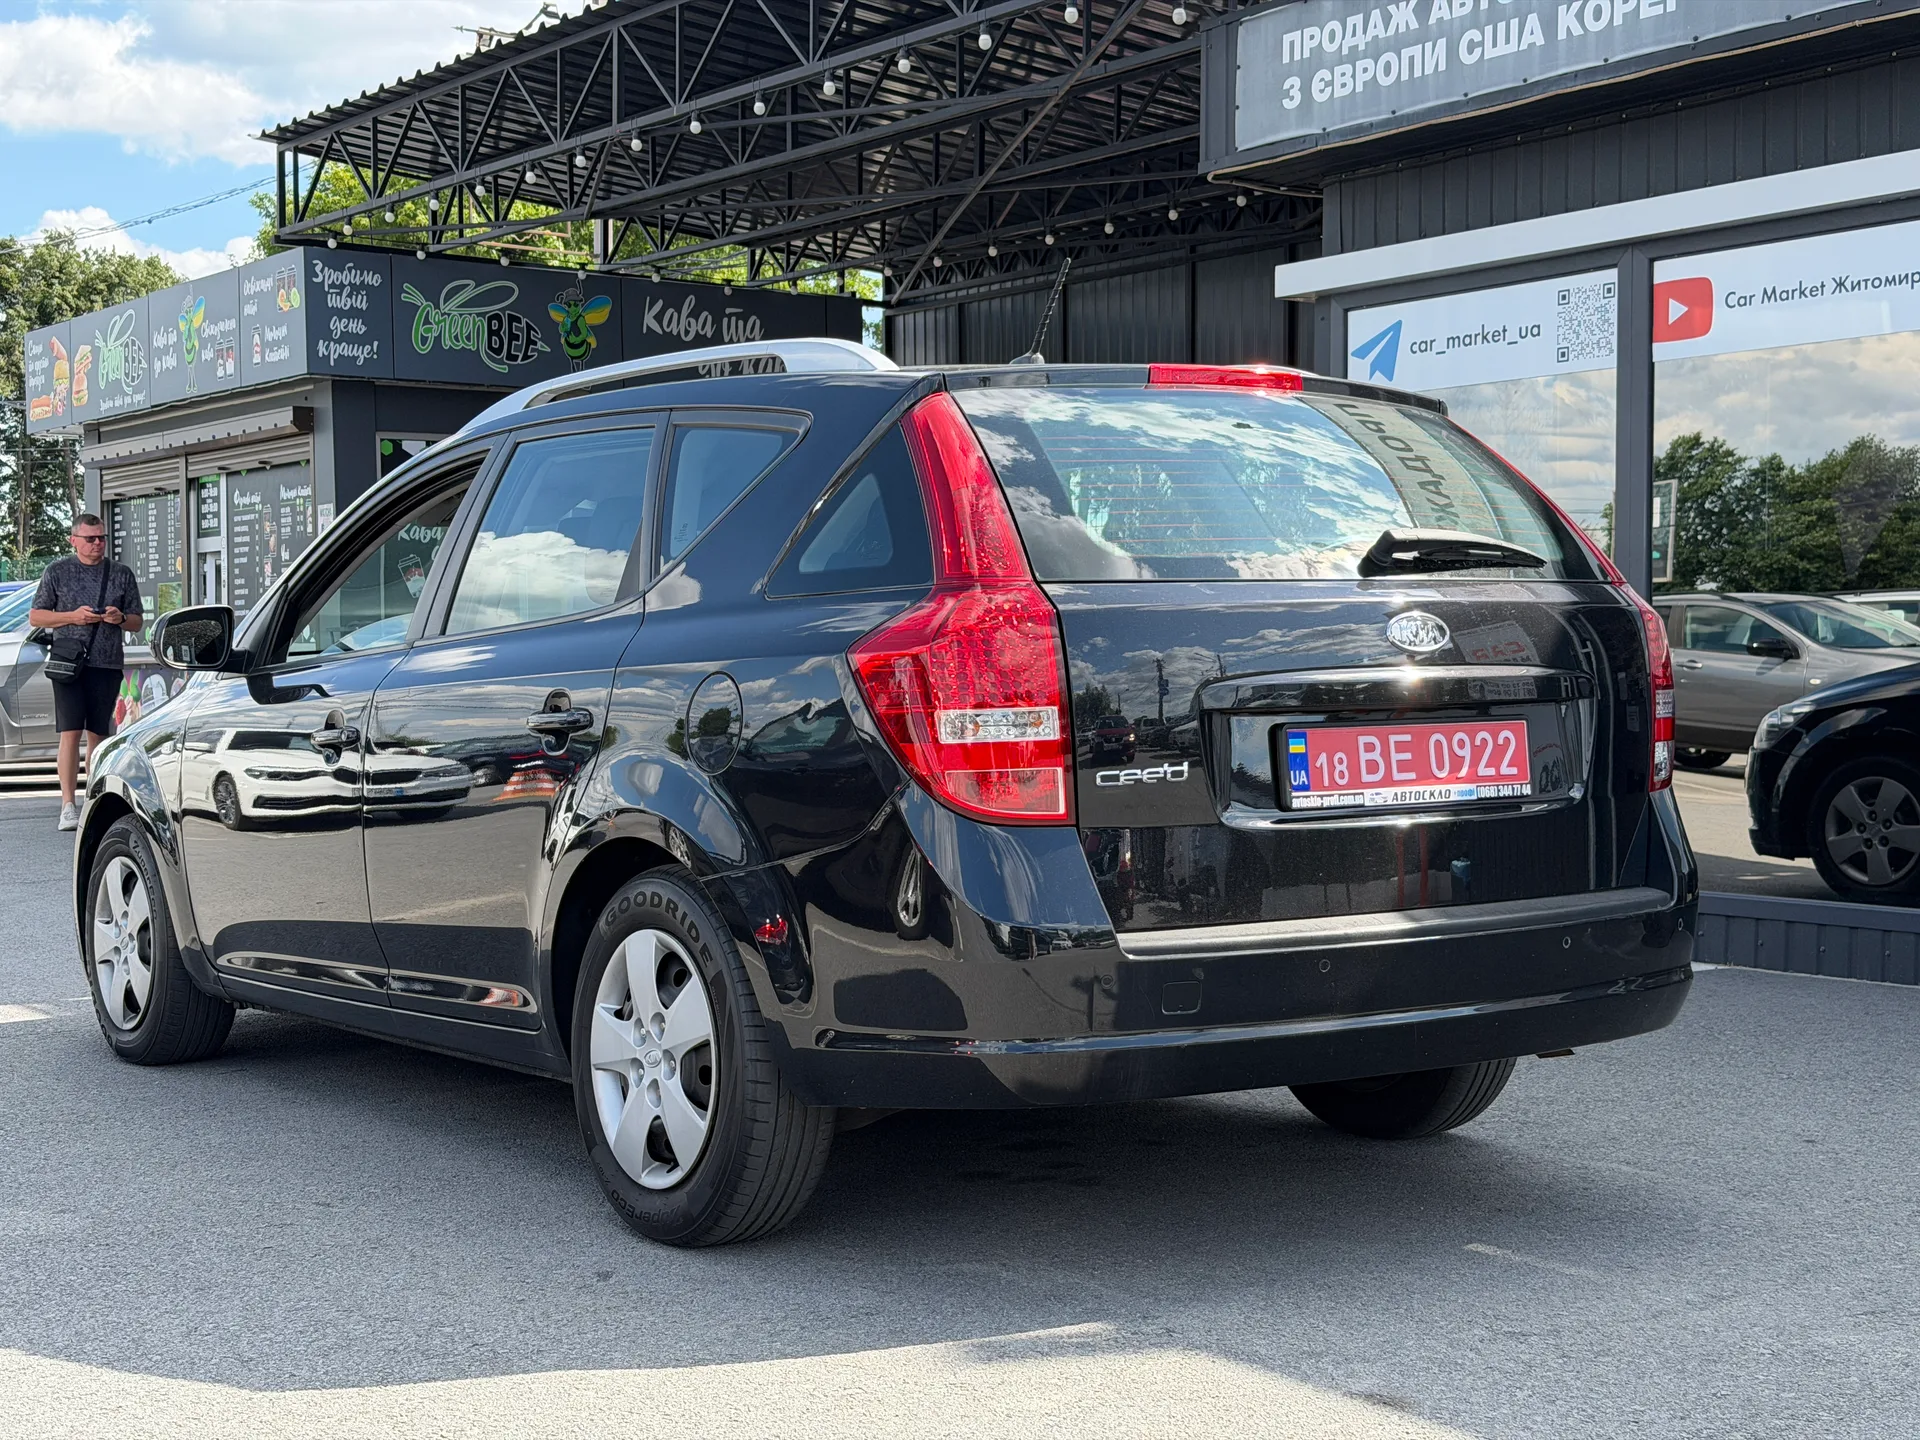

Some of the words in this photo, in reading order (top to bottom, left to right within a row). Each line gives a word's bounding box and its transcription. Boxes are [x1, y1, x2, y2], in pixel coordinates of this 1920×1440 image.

[1282, 0, 1419, 65] ПРОДАЖ
[1282, 75, 1302, 110] З
[1311, 36, 1447, 103] ЄВРОПИ
[1458, 12, 1545, 65] США
[312, 259, 382, 291] Зробимо
[1724, 291, 1756, 309] Car
[1760, 279, 1826, 305] Market
[1831, 270, 1920, 295] Житомир
[327, 286, 368, 311] твій
[330, 315, 367, 340] день
[643, 294, 717, 342] Кава
[722, 307, 765, 343] та
[317, 339, 379, 367] краще!
[1410, 323, 1541, 355] car_market_ua
[1314, 751, 1349, 787] 18
[1357, 733, 1416, 783] BE
[1428, 729, 1518, 779] 0922
[1290, 770, 1308, 786] UA
[1391, 788, 1451, 803] АВТОСКЛО
[604, 890, 713, 968] GOODRIDE
